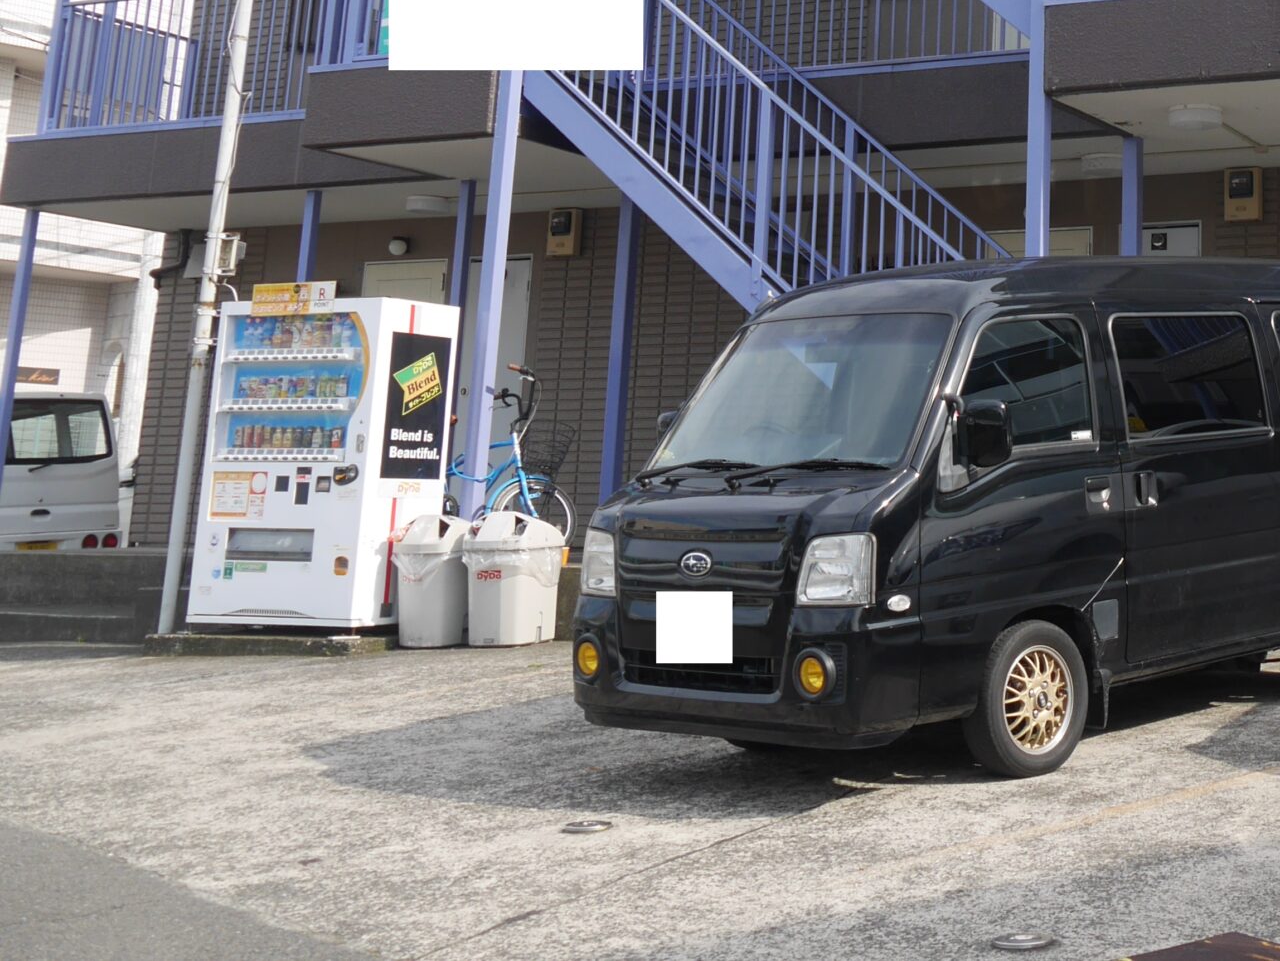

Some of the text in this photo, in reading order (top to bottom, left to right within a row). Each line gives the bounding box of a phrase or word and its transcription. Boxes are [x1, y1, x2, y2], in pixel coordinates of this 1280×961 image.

[319, 287, 327, 300] R
[406, 370, 437, 396] Blend
[390, 427, 434, 443] Blend is
[388, 446, 440, 460] Beautiful.
[476, 569, 502, 582] DyDo
